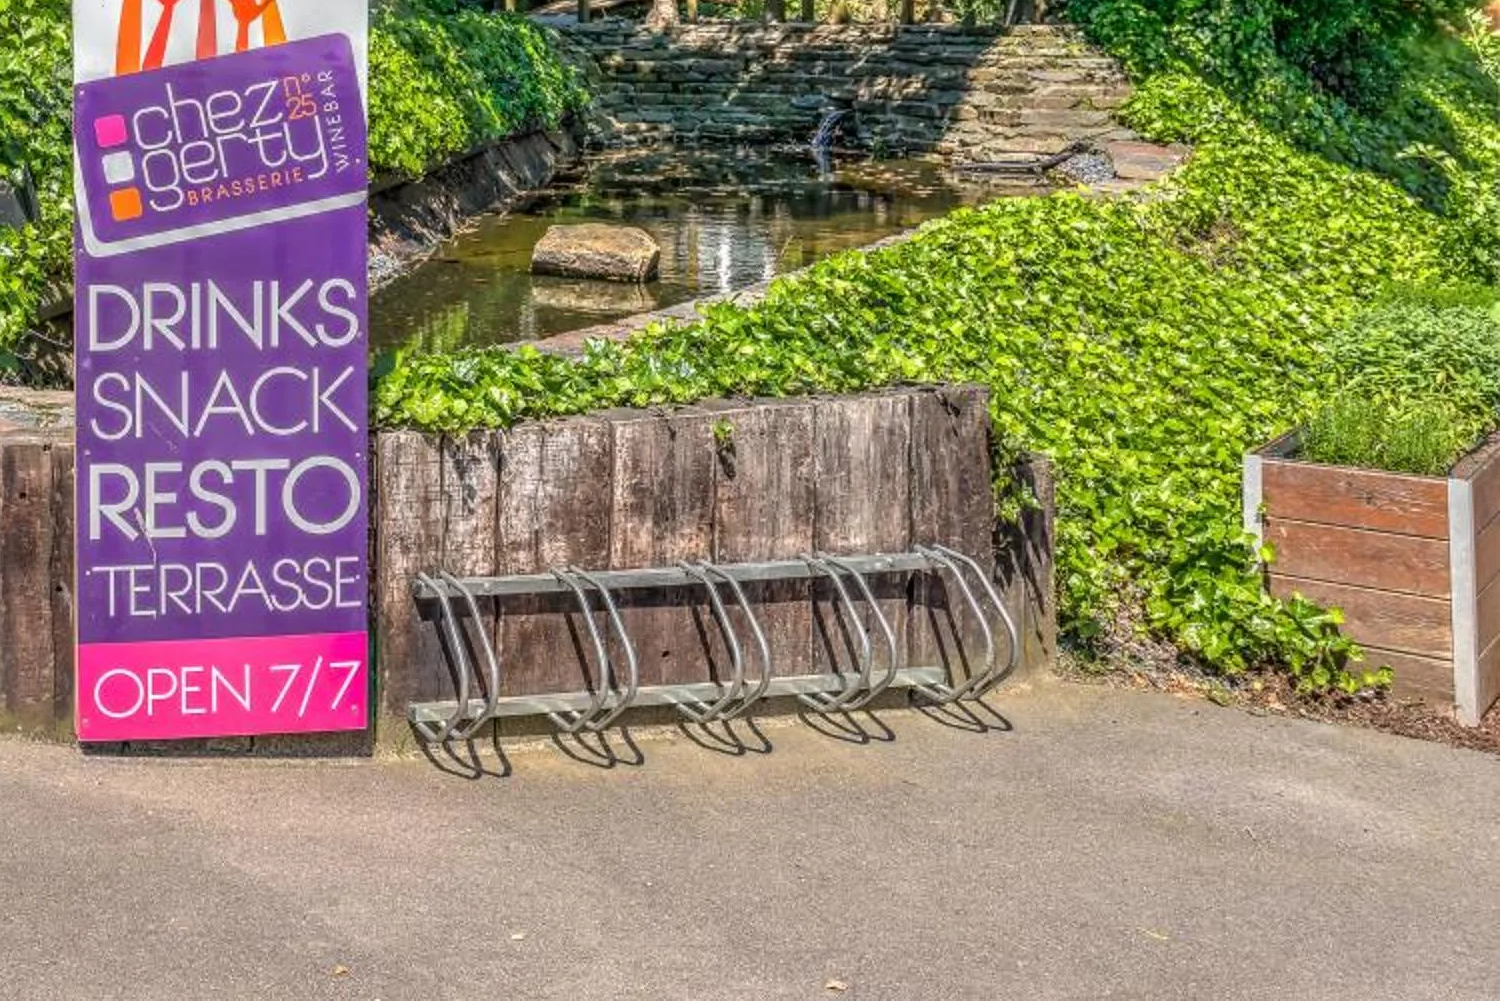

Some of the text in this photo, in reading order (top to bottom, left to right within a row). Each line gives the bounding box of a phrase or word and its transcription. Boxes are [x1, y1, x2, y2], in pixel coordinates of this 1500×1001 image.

[132, 79, 284, 150] chez
[286, 94, 318, 120] 25
[142, 114, 328, 212] gerty
[187, 166, 304, 207] BRASSERIE
[89, 278, 359, 352] DRINKS
[91, 366, 359, 440] SNACK
[89, 456, 361, 541] RESTO
[92, 556, 362, 618] TERRASSE
[94, 656, 361, 719] OPEN 7/7
